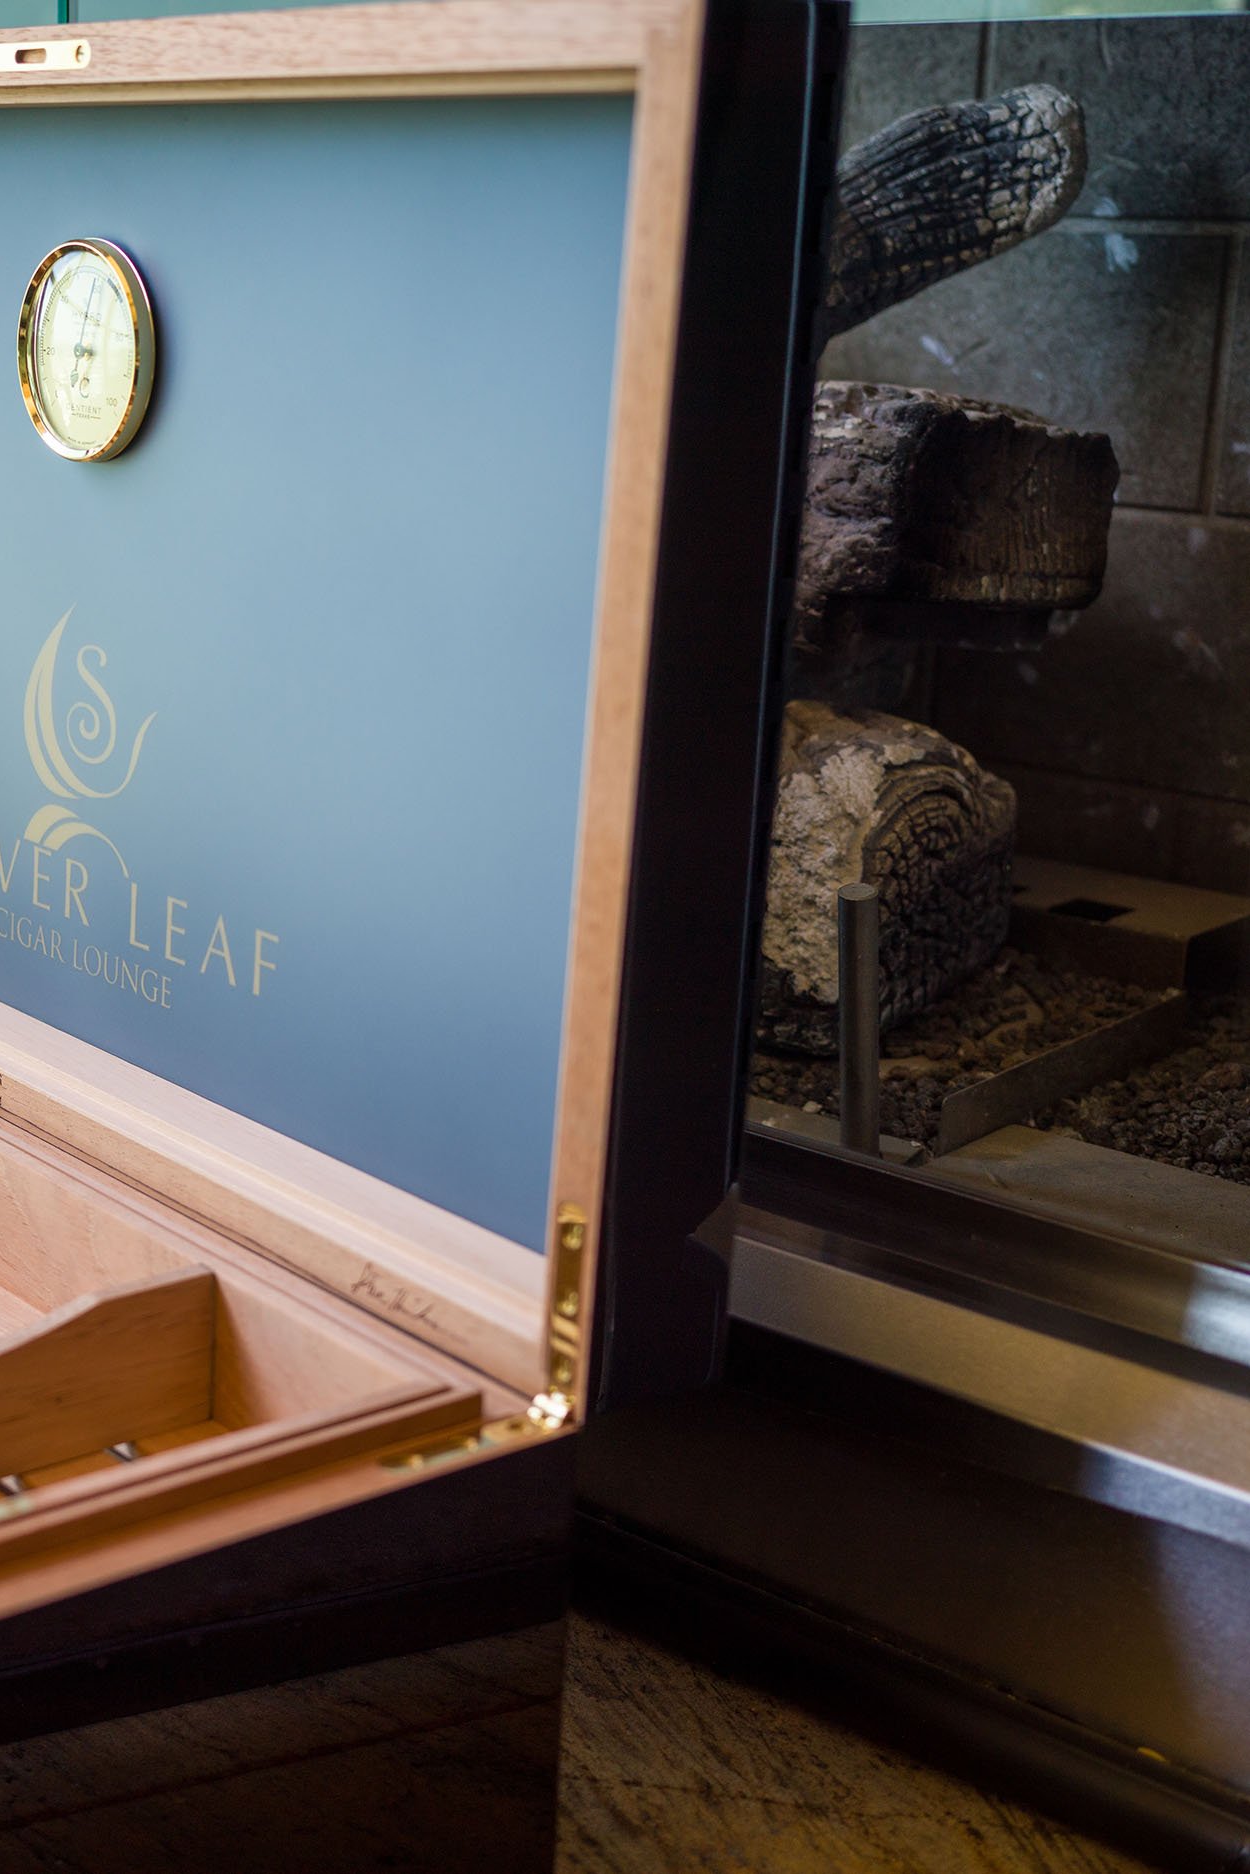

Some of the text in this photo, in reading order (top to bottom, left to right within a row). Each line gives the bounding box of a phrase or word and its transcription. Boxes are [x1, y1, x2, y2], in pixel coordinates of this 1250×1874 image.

[46, 346, 56, 356] 20
[105, 396, 118, 407] 100
[129, 882, 280, 997] LEAF
[73, 938, 172, 1009] LOUNGE
